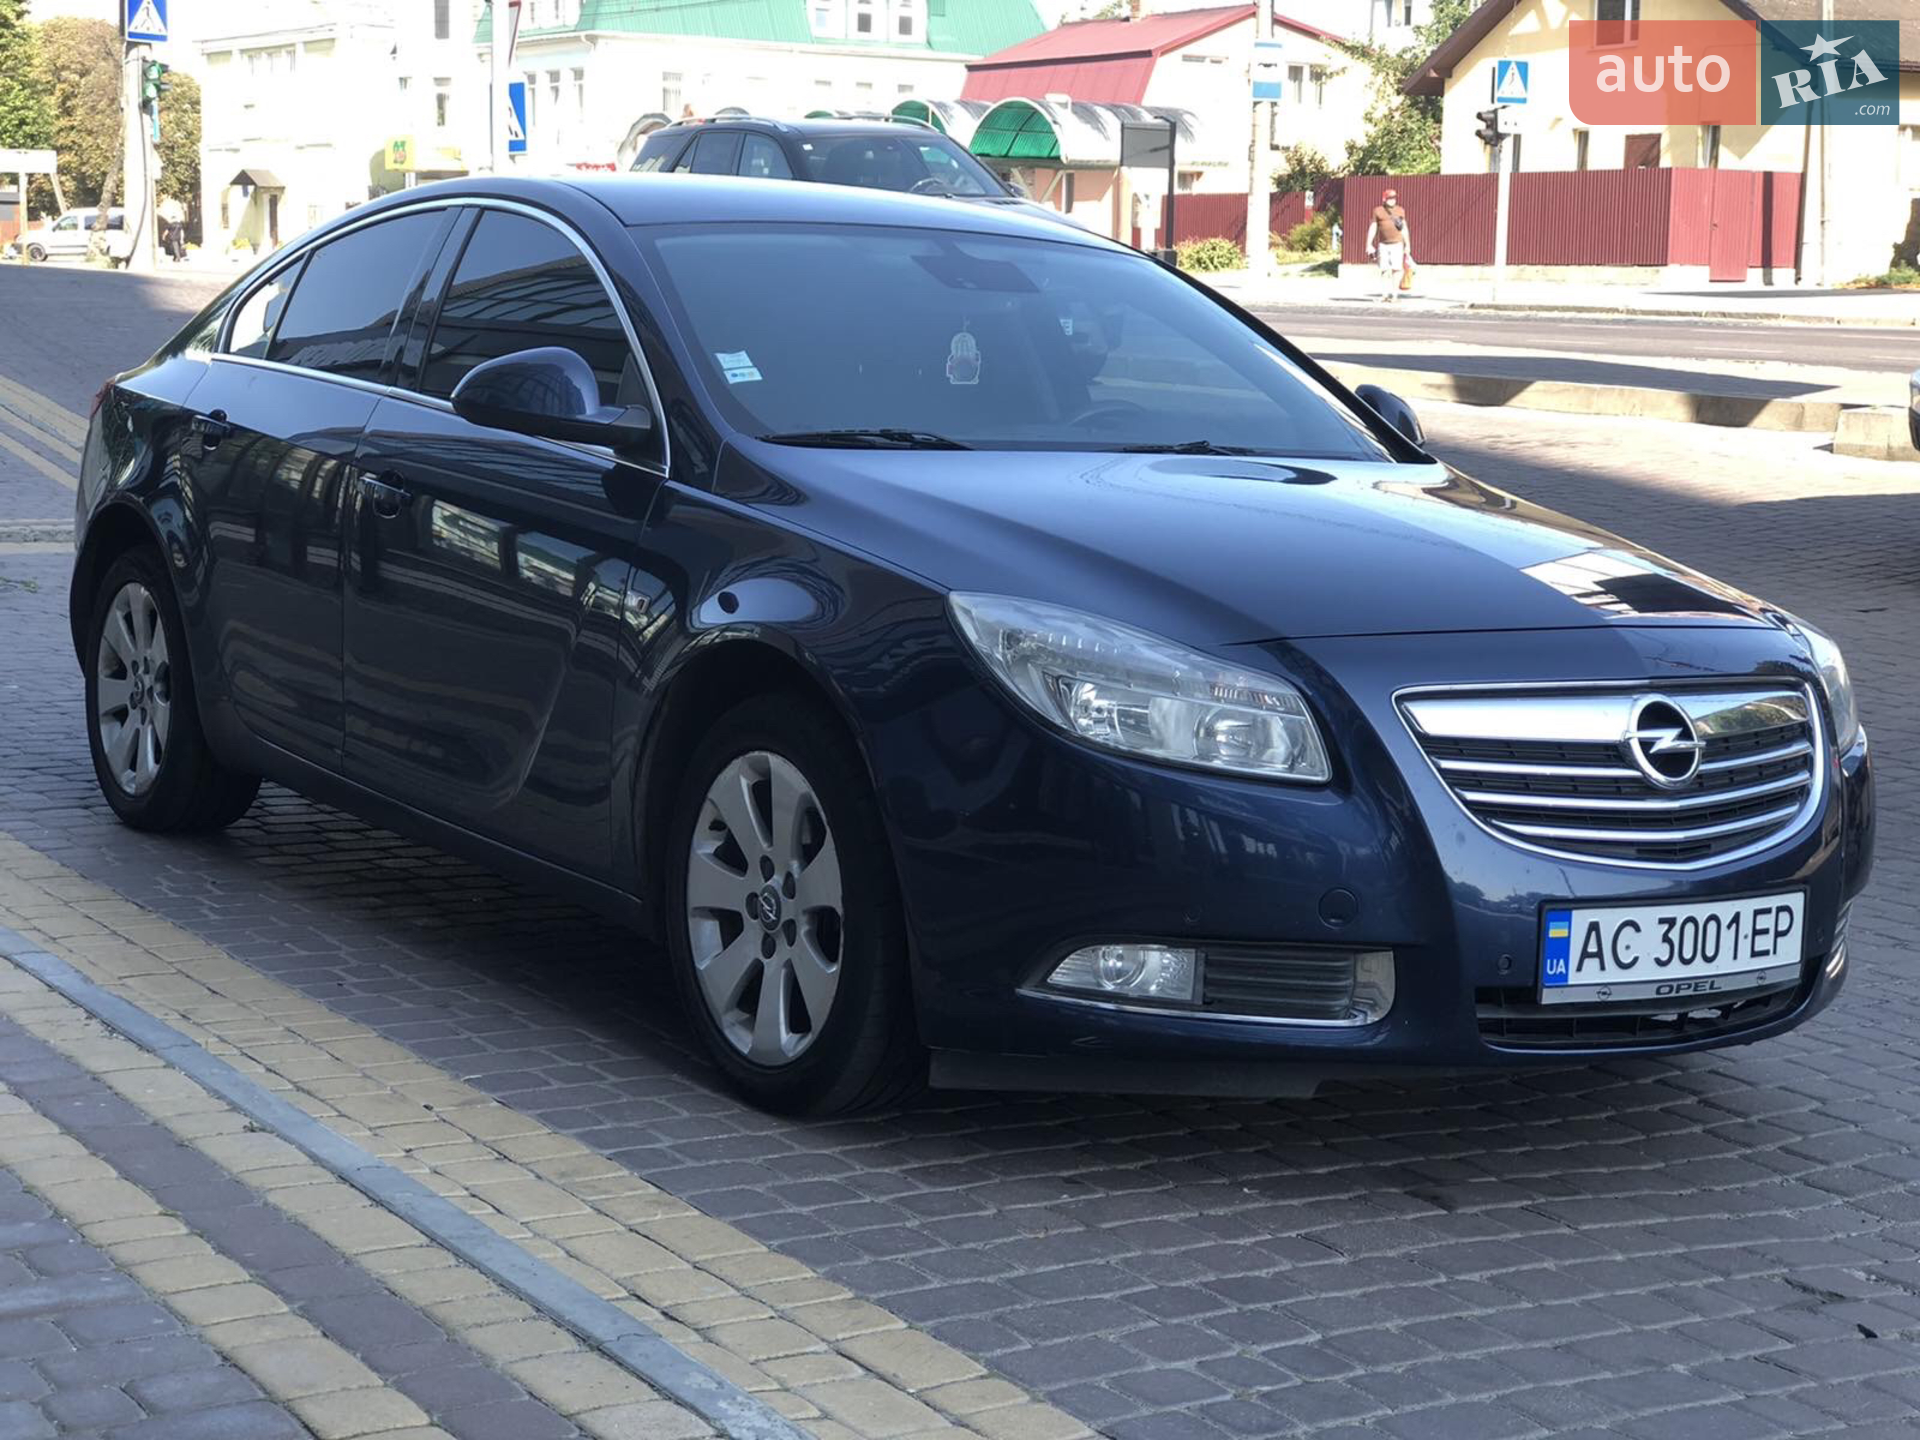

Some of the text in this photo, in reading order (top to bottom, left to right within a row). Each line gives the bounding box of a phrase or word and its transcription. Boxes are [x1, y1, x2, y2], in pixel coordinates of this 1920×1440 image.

[1575, 904, 1795, 973] AC 3001 EP
[1546, 958, 1566, 975] UA
[1655, 980, 1722, 996] OPEL
